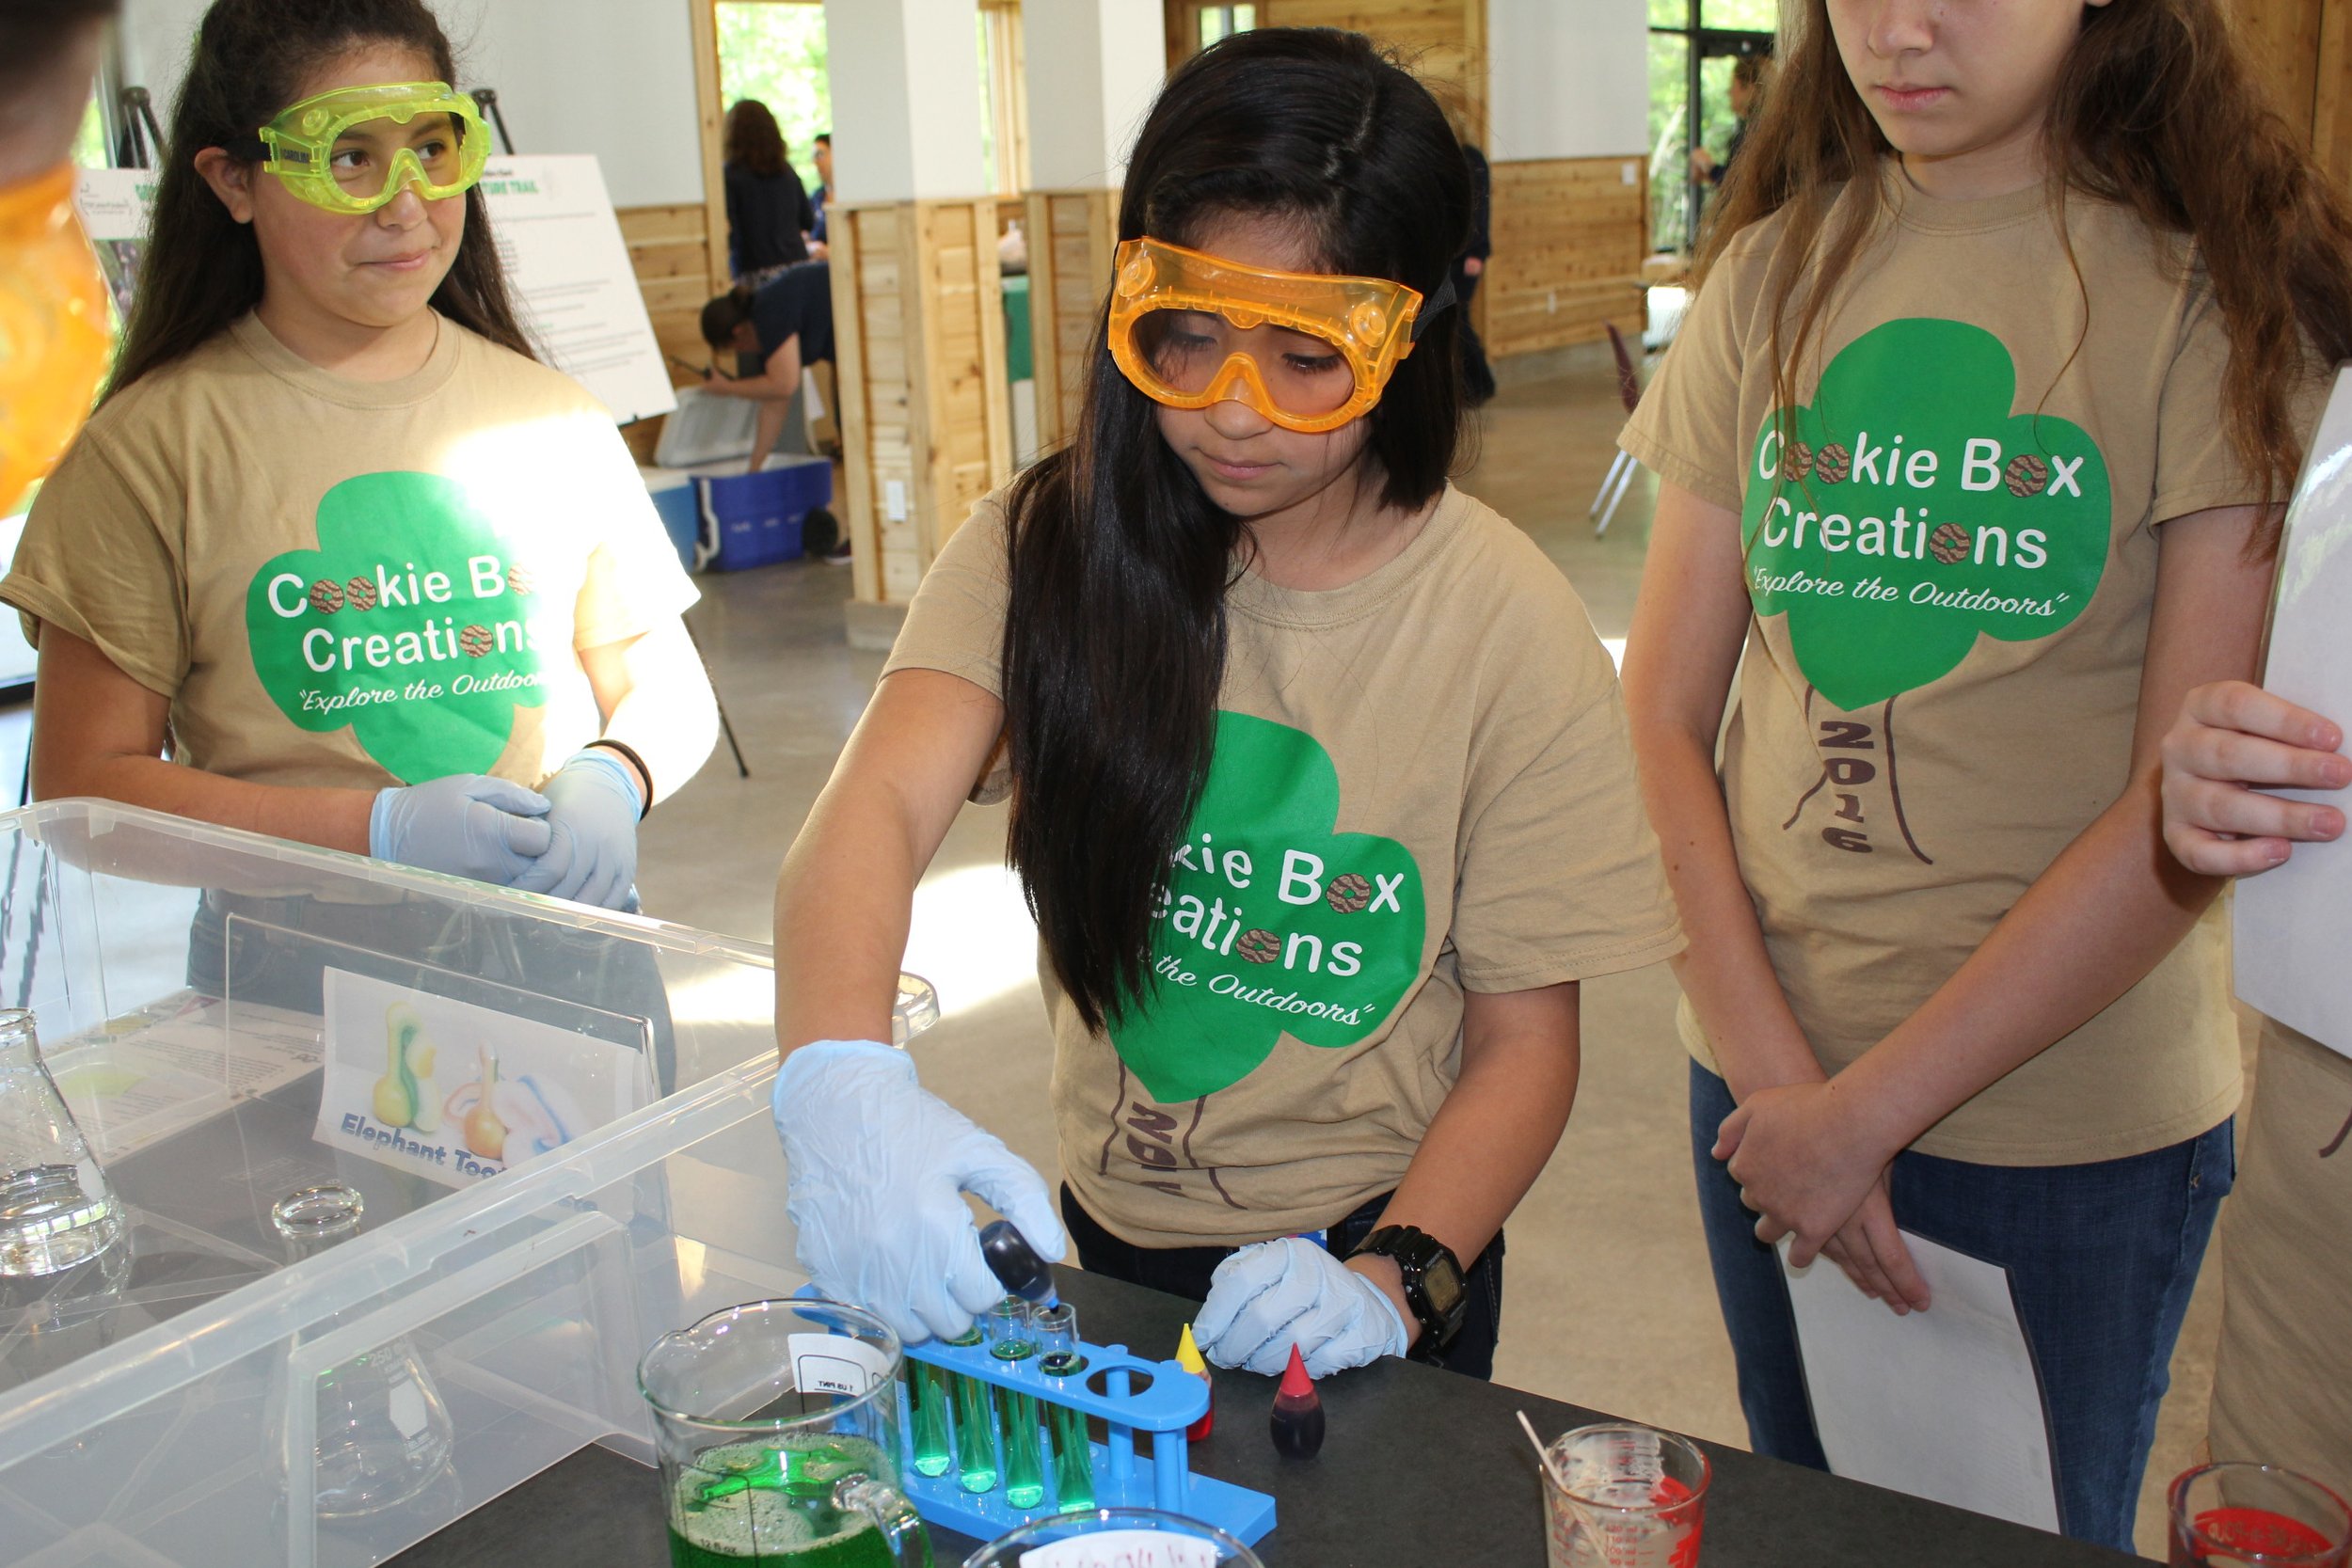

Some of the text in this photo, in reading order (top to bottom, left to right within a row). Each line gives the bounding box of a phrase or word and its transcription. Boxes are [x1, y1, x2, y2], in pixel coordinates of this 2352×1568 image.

[1759, 430, 2084, 498] Cookie Box
[1763, 497, 2047, 569] Creations
[268, 554, 536, 618] Cookie Bo
[1851, 577, 1899, 603] the
[1909, 581, 2070, 617] Outdoors"
[298, 669, 548, 715] "Explore the Outdoo
[1818, 721, 1876, 853] 2016
[1169, 833, 1404, 914] kie Box
[1150, 881, 1362, 977] eations
[1155, 955, 1375, 1025] the Outdoors"
[340, 1113, 447, 1165] Elephant
